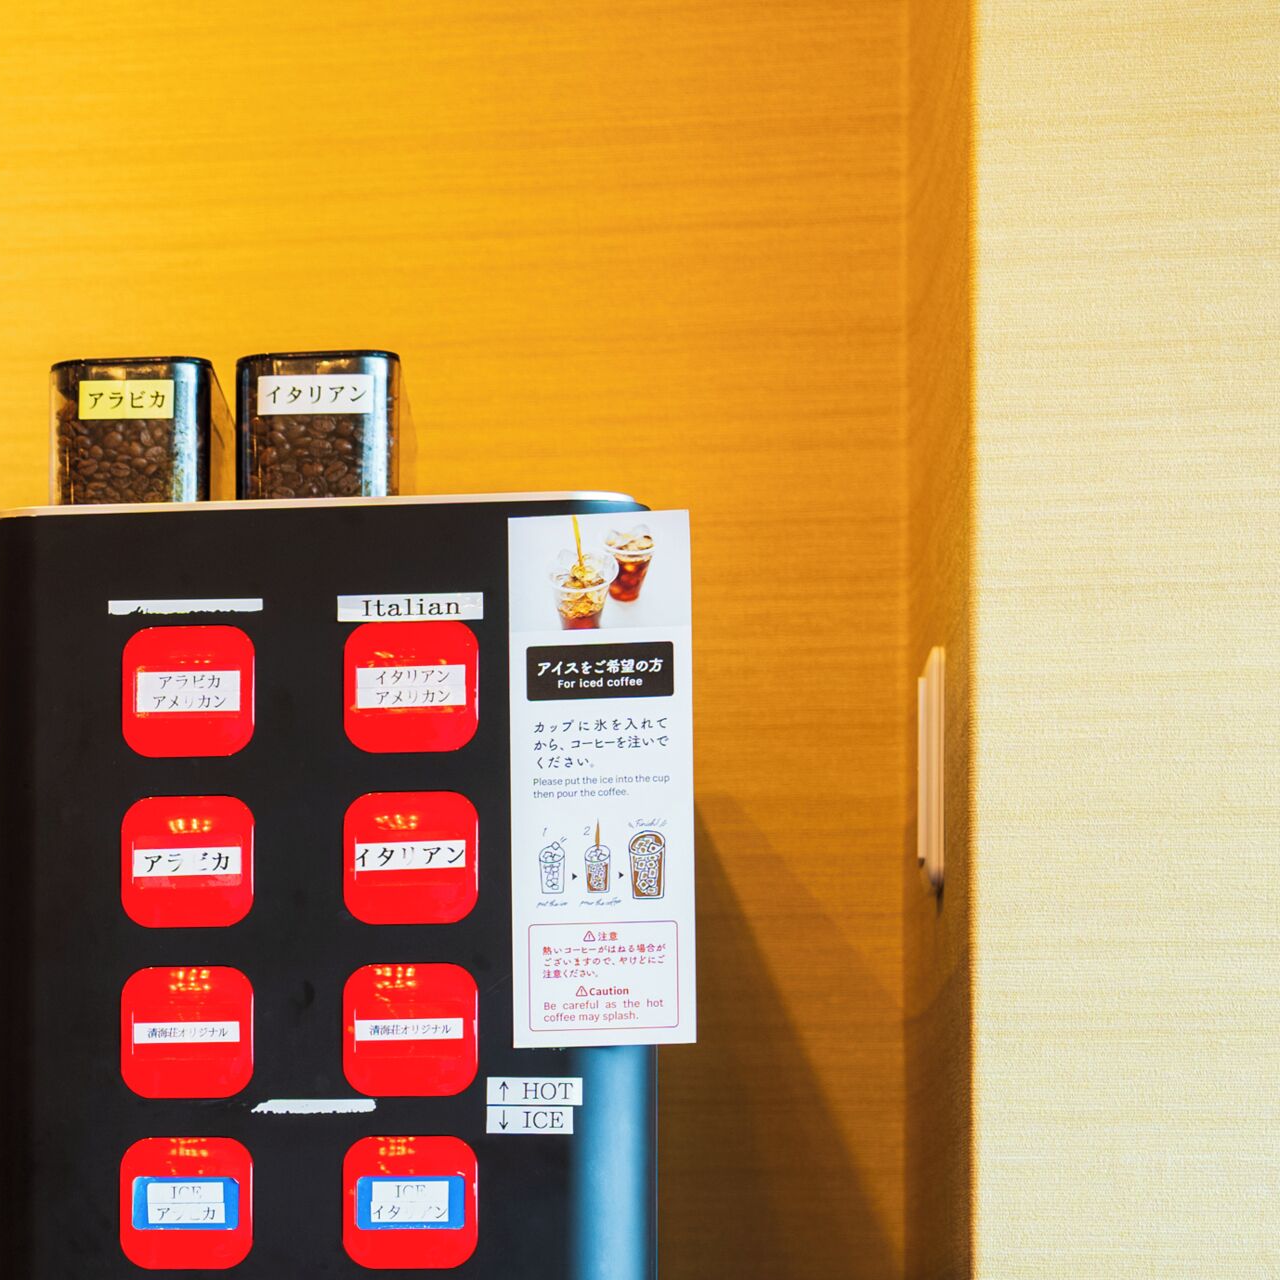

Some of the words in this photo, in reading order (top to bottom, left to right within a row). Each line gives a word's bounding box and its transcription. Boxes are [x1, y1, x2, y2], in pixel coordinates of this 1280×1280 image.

[87, 390, 167, 410] アラビカ
[265, 384, 367, 405] イタリアン
[362, 597, 462, 618] Italian
[537, 658, 664, 676] アイスをご希望の方
[159, 674, 221, 689] アラビカ
[376, 669, 449, 685] イタリアン
[558, 679, 576, 688] For
[580, 678, 603, 687] iced
[607, 676, 643, 687] coffee
[153, 694, 226, 709] アメリカン
[376, 689, 450, 704] アメリカン
[534, 717, 668, 733] カップに氷を入れて
[534, 735, 670, 751] から、コーヒーを注いで
[535, 756, 595, 769] ください。
[533, 777, 562, 786] Please
[565, 777, 580, 787] put
[582, 776, 597, 784] the
[616, 775, 633, 783] into
[635, 774, 650, 782] the
[652, 775, 670, 784] cup
[533, 790, 554, 798] then
[557, 790, 577, 799] pour
[580, 788, 595, 797] the
[598, 787, 629, 797] coffee.
[583, 826, 591, 836] 2
[598, 931, 618, 941] 注意
[589, 986, 629, 996] Caution
[543, 1002, 556, 1010] Be
[562, 1000, 599, 1010] careful
[605, 1001, 616, 1009] as
[623, 999, 640, 1008] the
[646, 998, 664, 1008] hot
[543, 1012, 575, 1022] coffee
[578, 1013, 599, 1022] may
[602, 1010, 639, 1022] splash.
[523, 1083, 573, 1100] HOT
[523, 1111, 564, 1129] ICE
